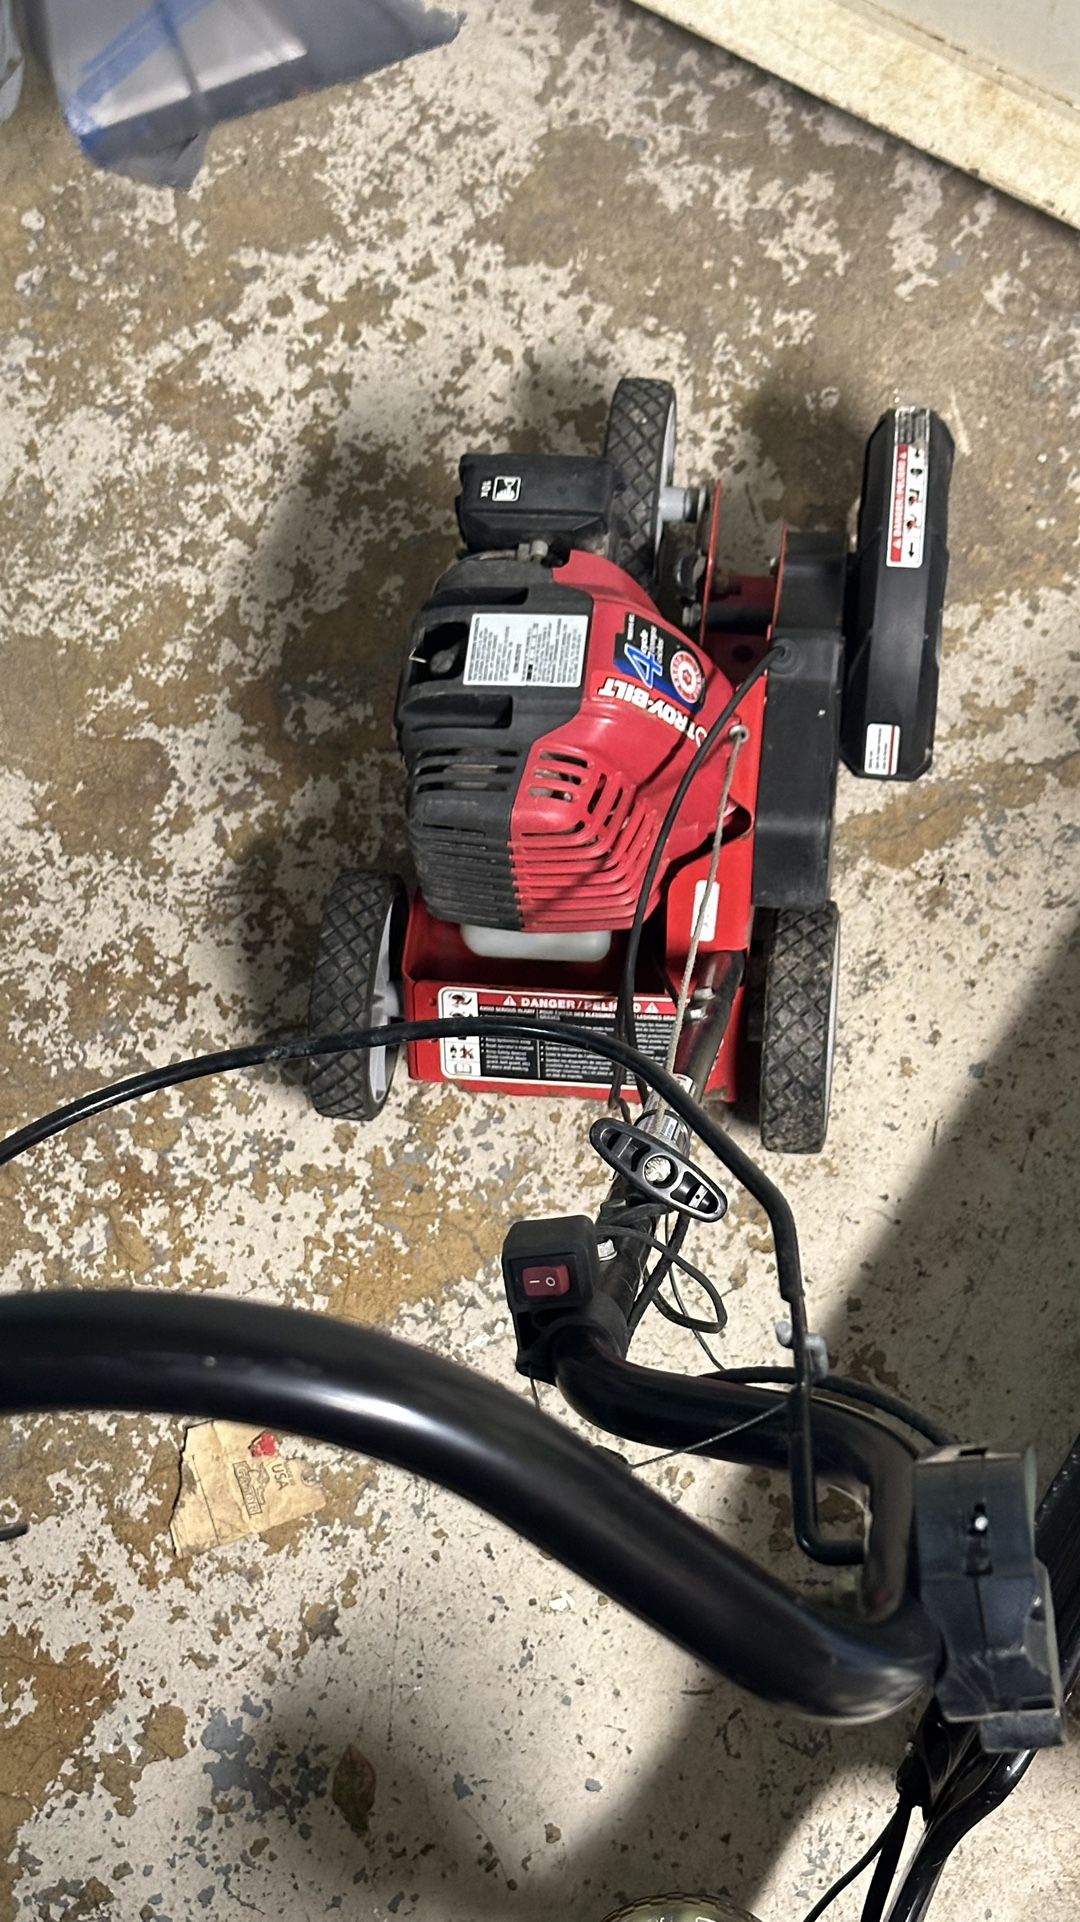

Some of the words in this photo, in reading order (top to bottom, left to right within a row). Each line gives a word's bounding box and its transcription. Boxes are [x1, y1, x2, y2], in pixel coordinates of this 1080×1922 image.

[624, 643, 663, 689] 4
[598, 677, 696, 740] TROY-BILT
[271, 1463, 289, 1490] USA
